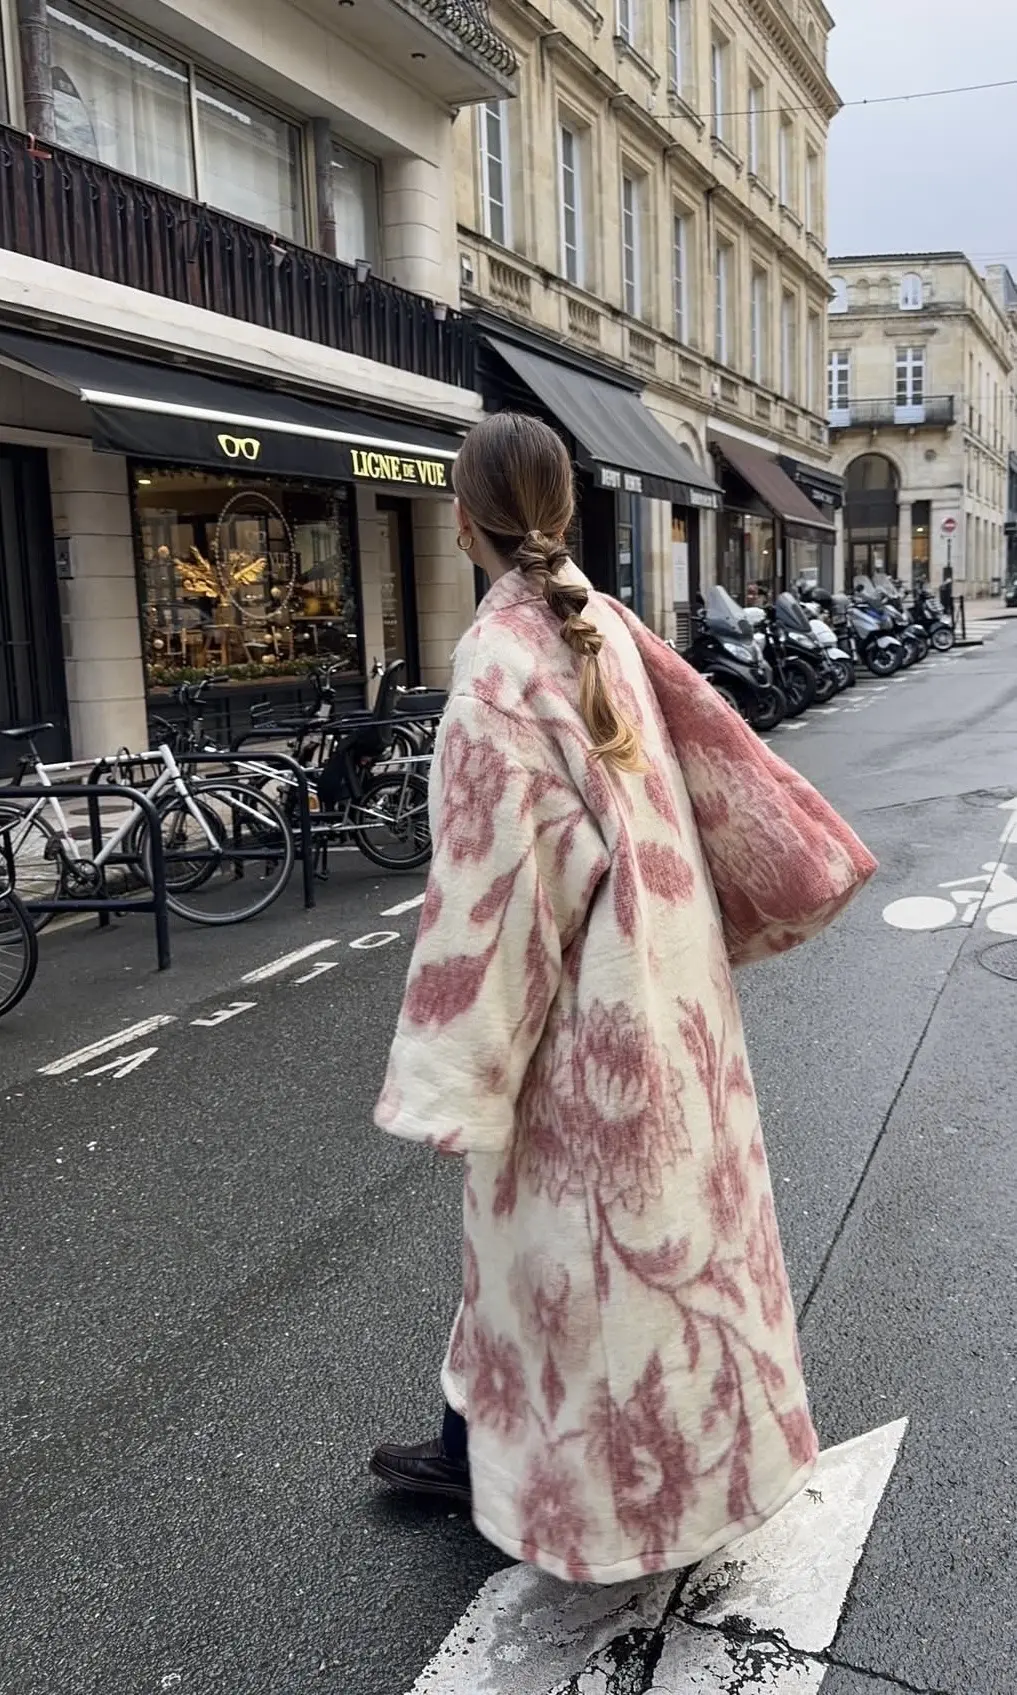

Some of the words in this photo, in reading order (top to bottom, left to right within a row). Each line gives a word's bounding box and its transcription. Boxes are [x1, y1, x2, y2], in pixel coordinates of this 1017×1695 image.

[351, 449, 401, 481] LIGNE
[402, 463, 416, 478] DE
[415, 460, 447, 487] VUE
